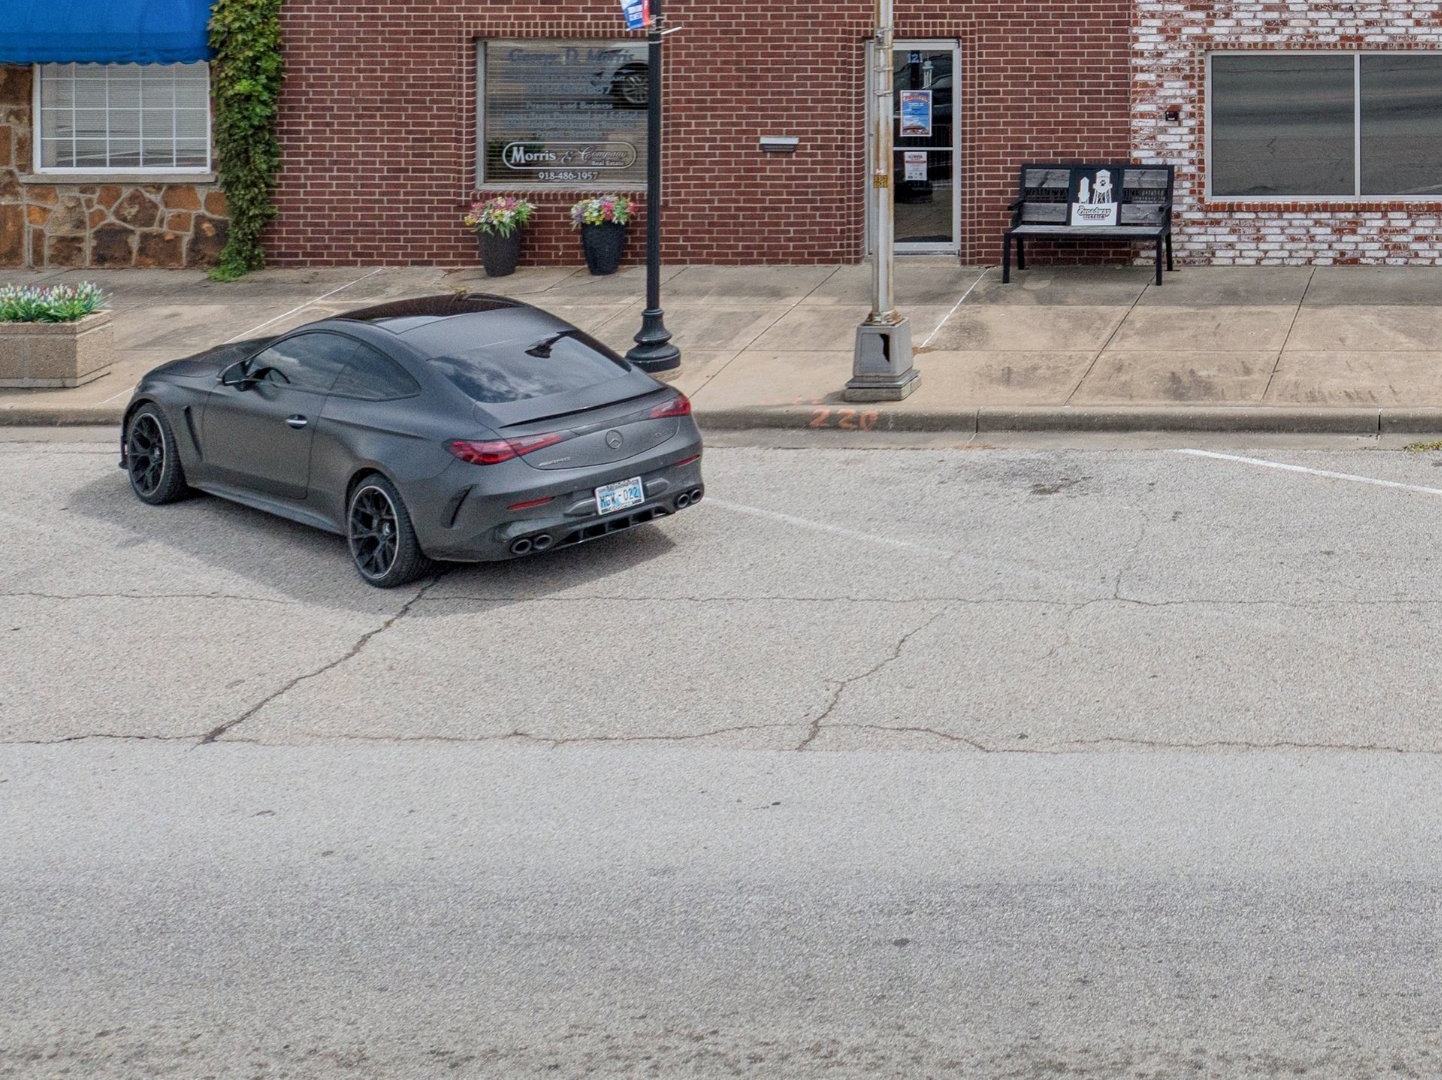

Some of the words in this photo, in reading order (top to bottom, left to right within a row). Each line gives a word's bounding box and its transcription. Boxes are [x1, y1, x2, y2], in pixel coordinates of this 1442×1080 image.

[510, 146, 557, 164] Morris
[578, 144, 628, 163] Company
[538, 171, 599, 180] 918-486-1957
